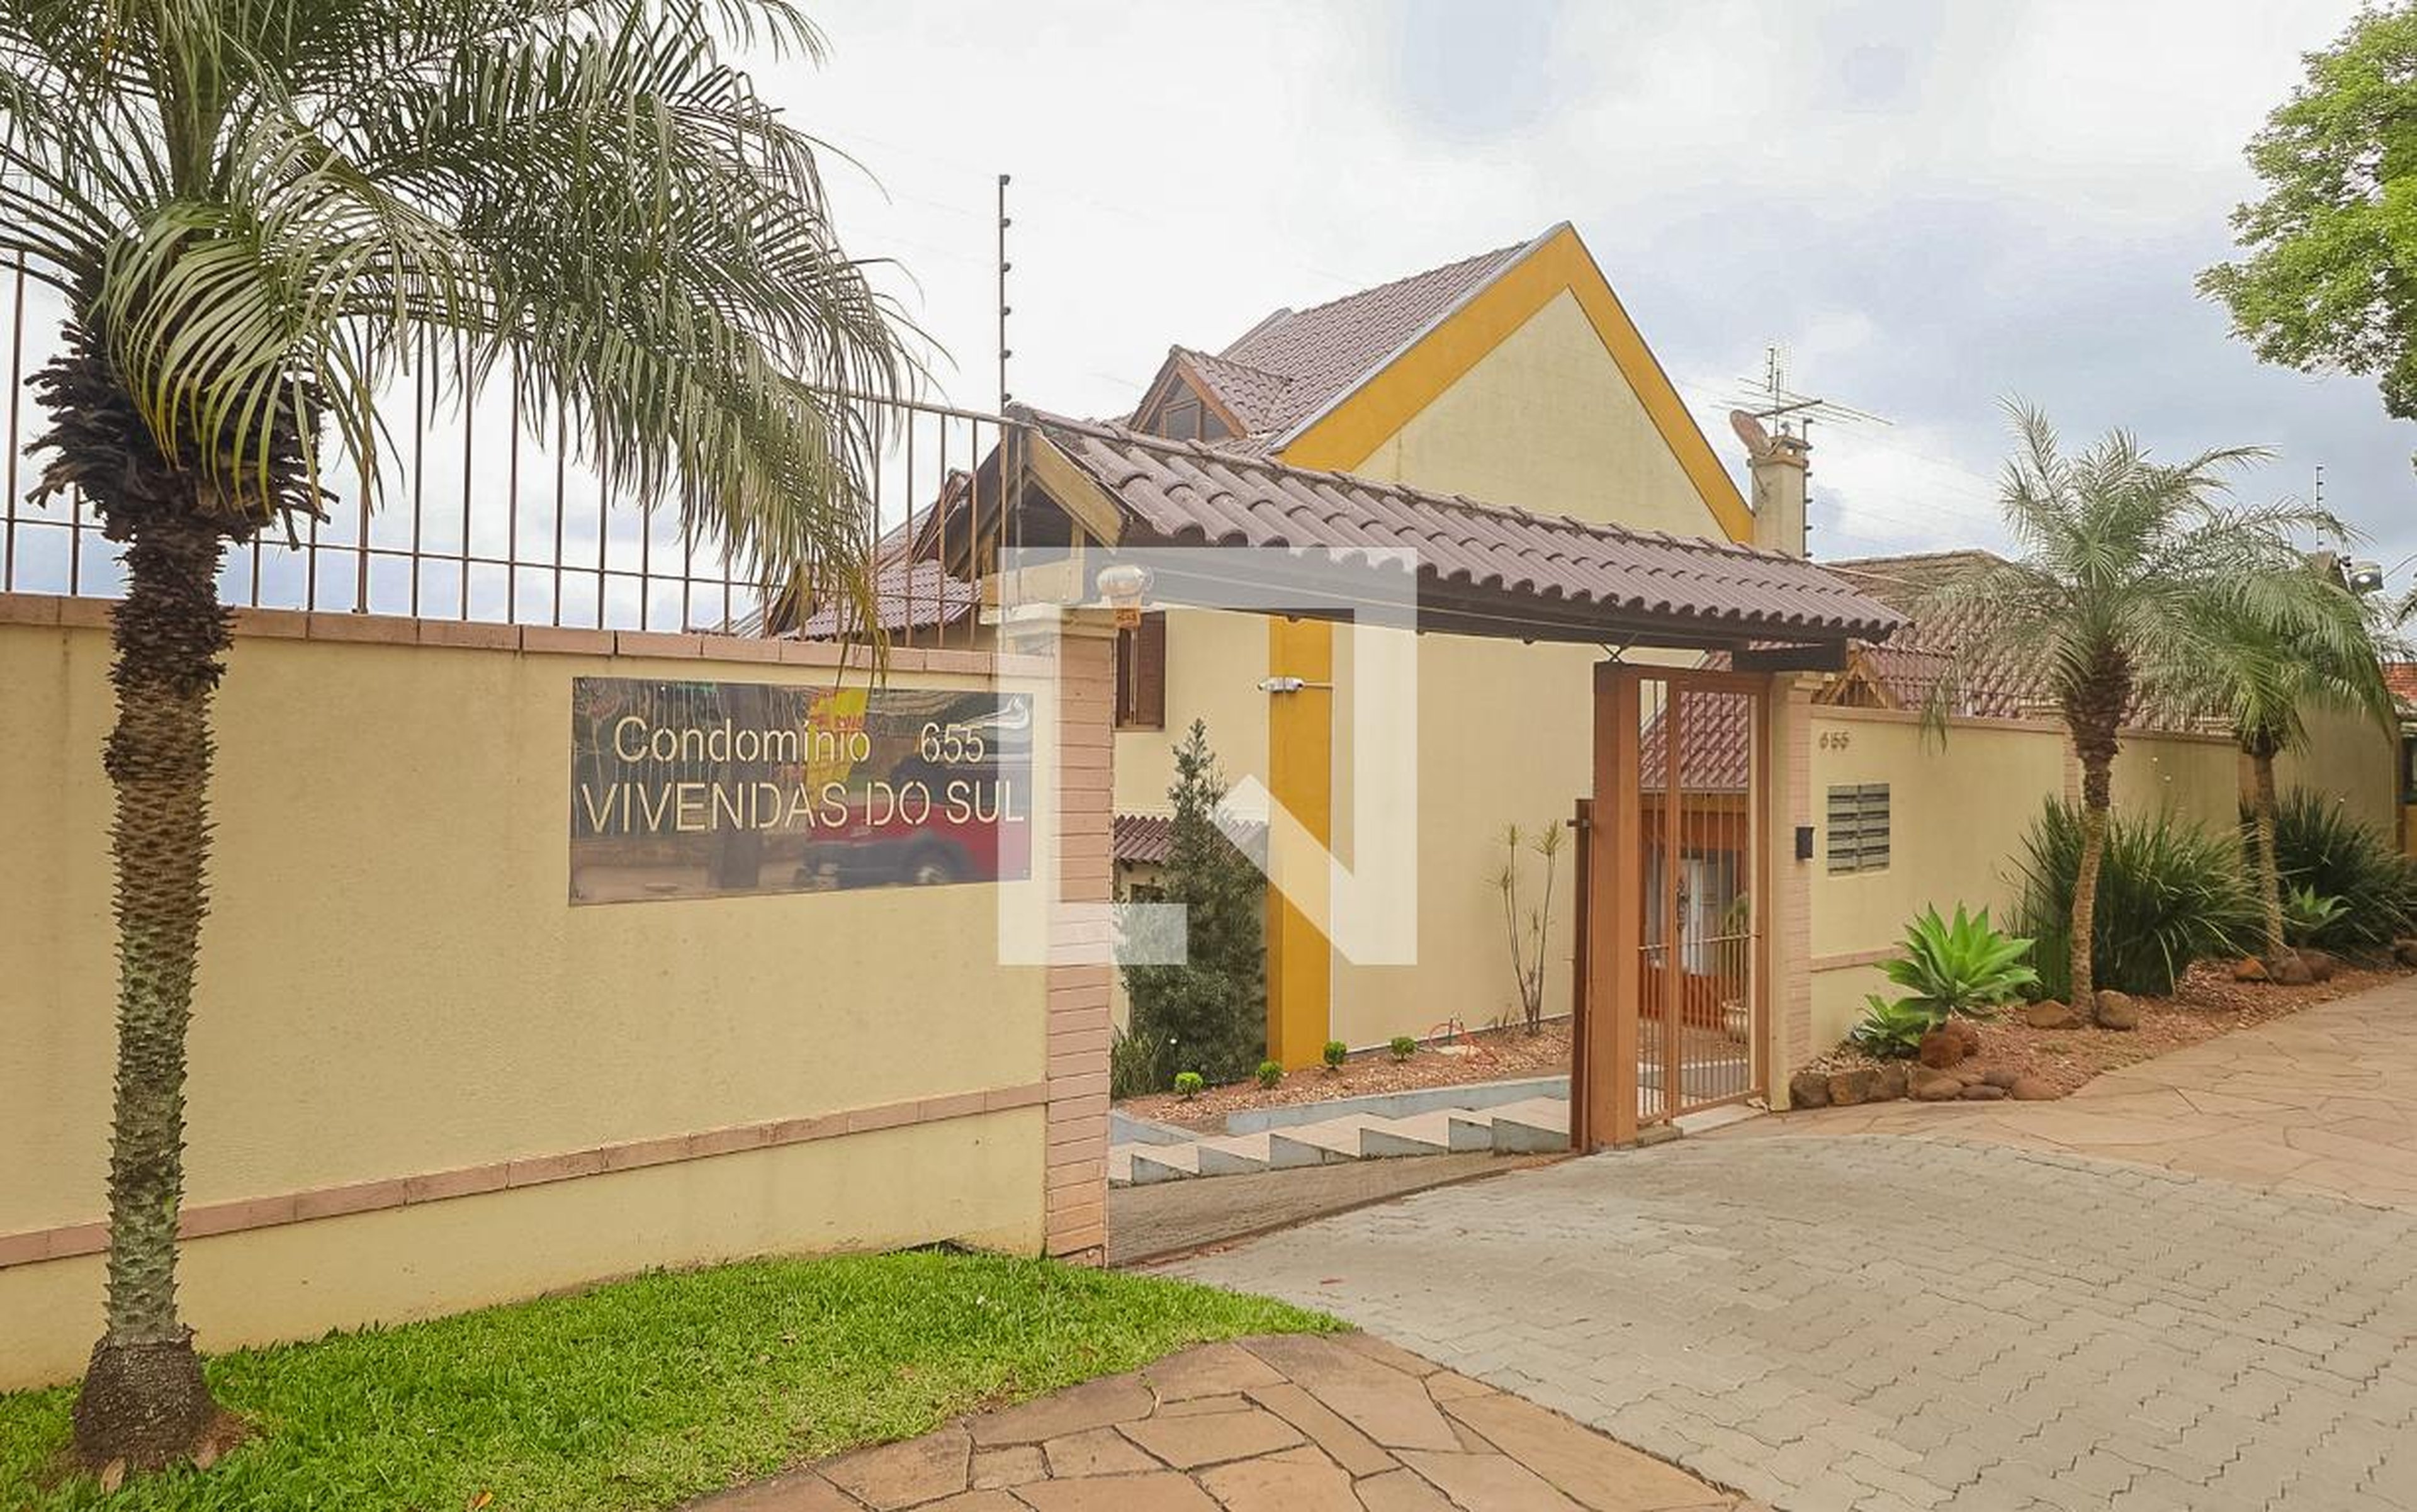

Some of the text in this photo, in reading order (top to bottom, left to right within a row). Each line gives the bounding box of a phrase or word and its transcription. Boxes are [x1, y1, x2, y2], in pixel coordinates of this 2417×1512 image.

[614, 716, 984, 762] Condomínio 655
[582, 779, 1025, 833] VIVENDAS DO SUL
